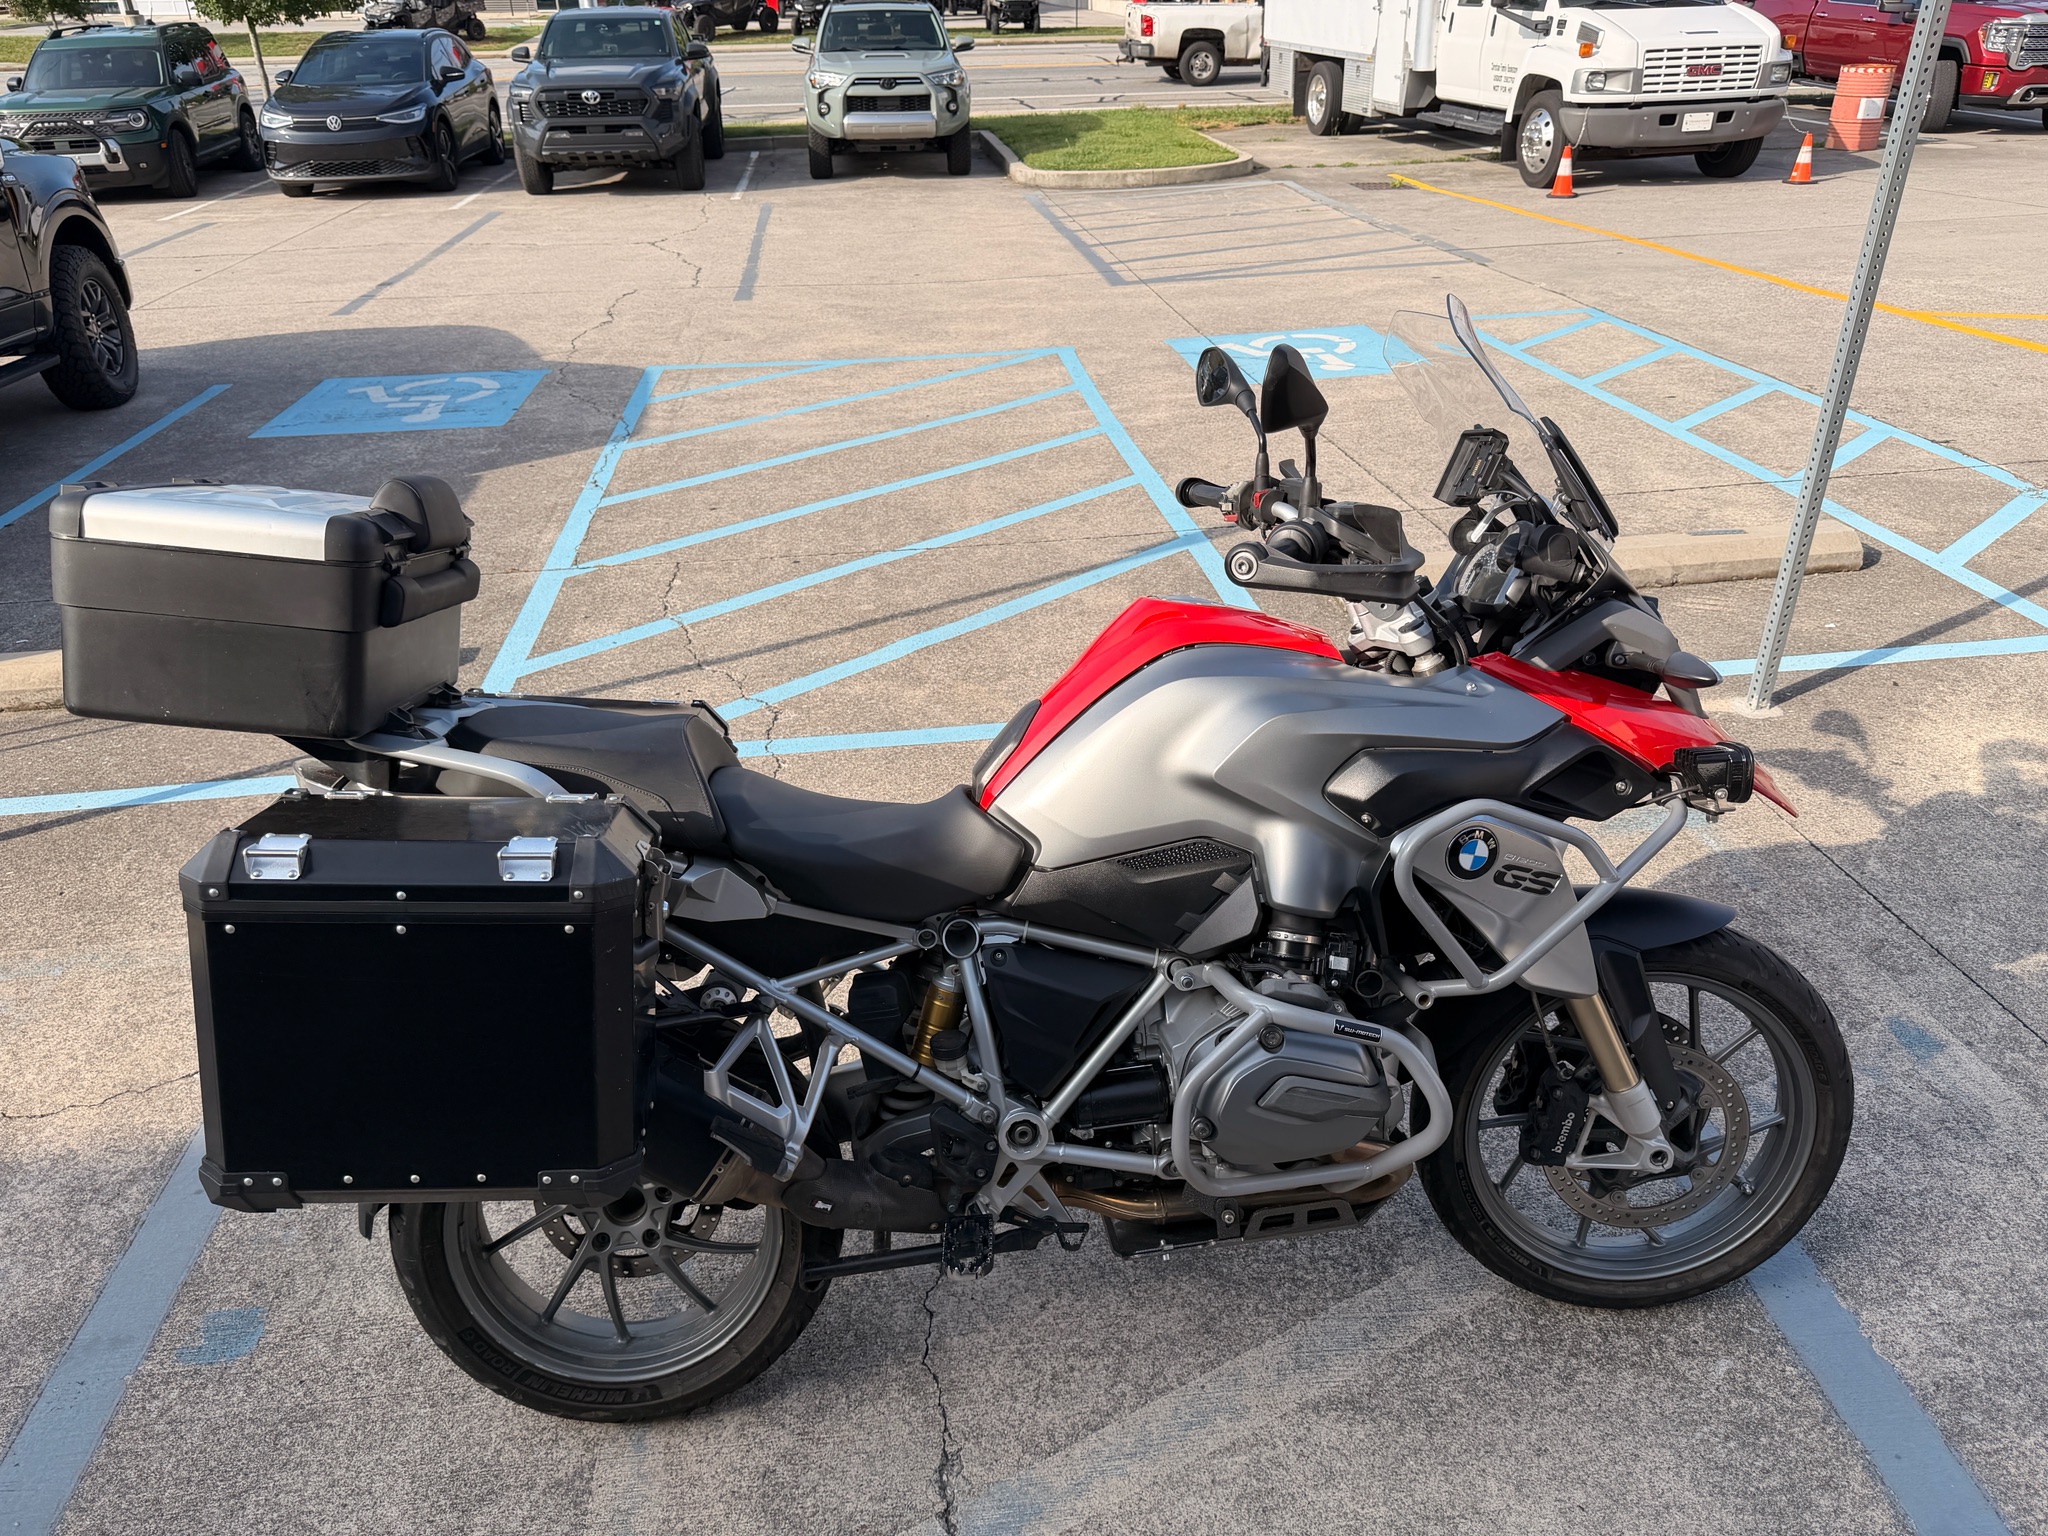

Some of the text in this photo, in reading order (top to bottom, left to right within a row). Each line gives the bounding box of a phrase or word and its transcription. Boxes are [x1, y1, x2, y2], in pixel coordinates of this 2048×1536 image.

[1686, 65, 1722, 77] GMC
[1458, 830, 1497, 850] BMW
[1493, 864, 1563, 896] GS
[1551, 1112, 1575, 1154] brembo
[473, 1341, 516, 1375] ROAD
[524, 1374, 628, 1404] MICHELIN
